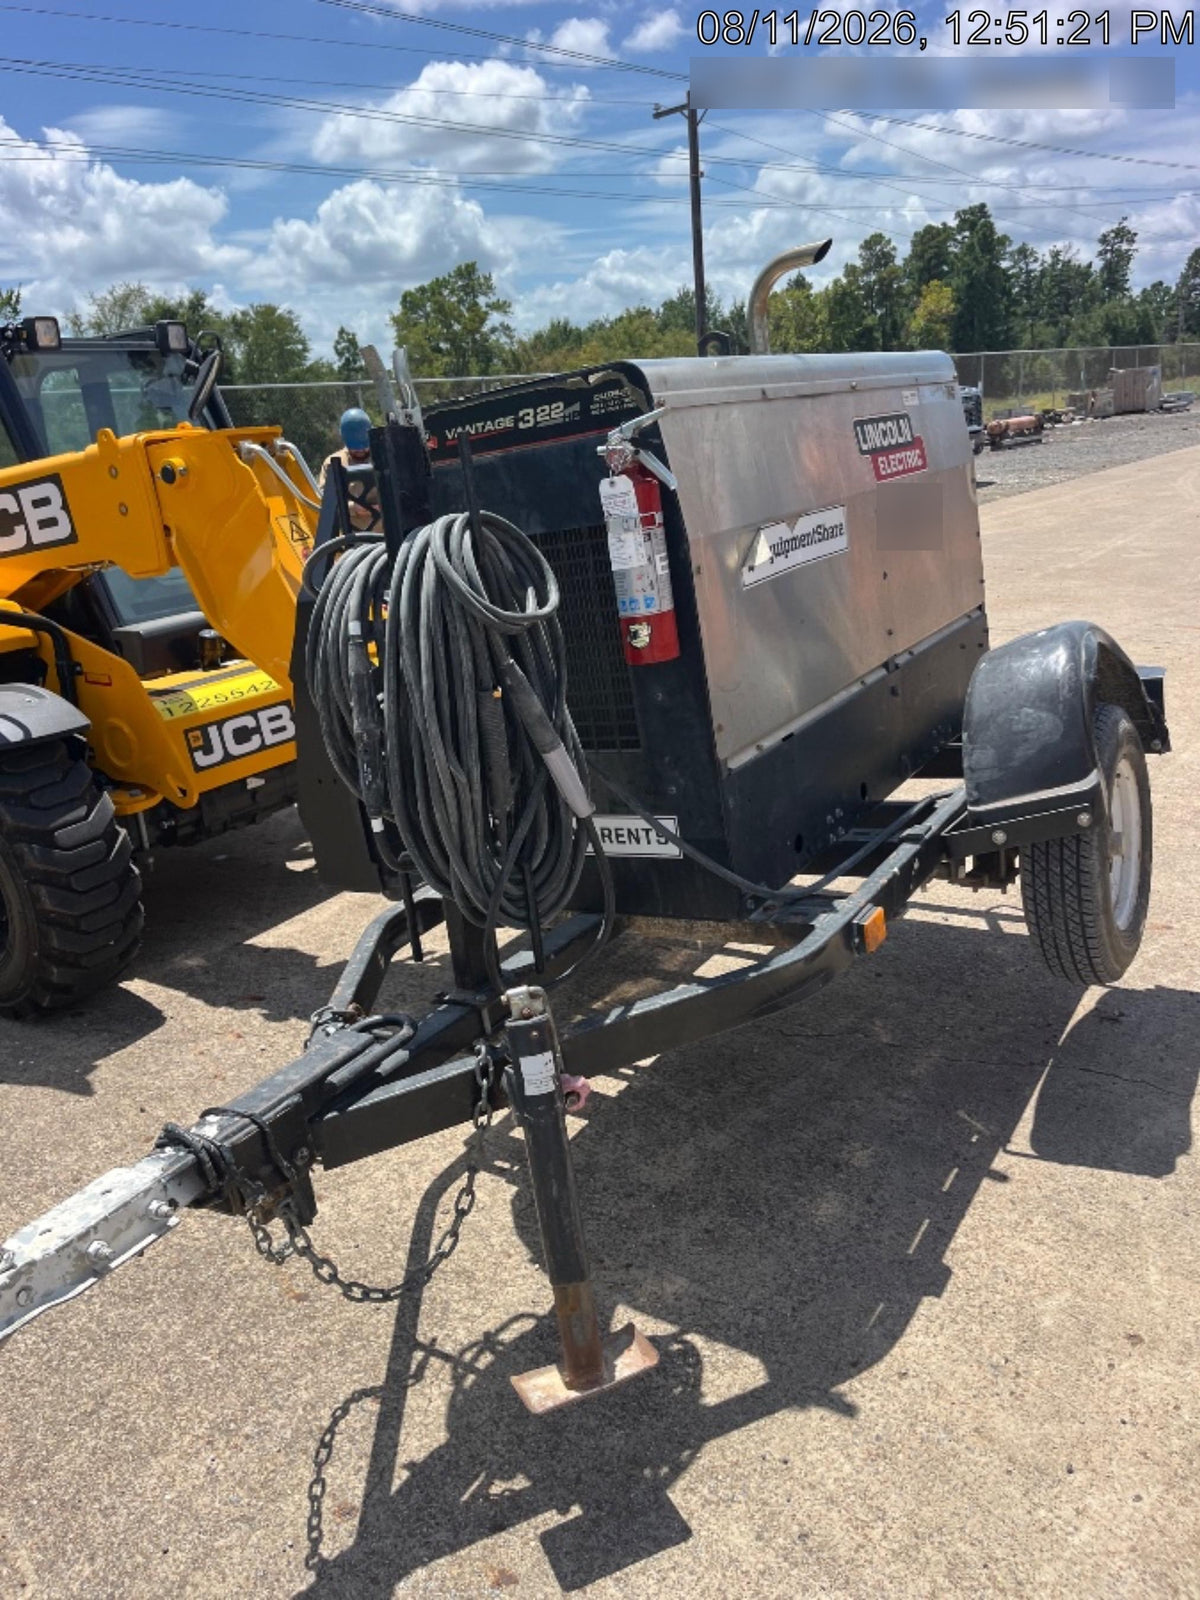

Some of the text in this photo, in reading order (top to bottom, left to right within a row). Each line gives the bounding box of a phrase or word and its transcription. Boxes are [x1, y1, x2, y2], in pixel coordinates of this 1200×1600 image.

[445, 415, 515, 440] VANTAGE
[518, 401, 565, 429] 322
[856, 418, 912, 451] LINCOLN
[877, 449, 923, 476] ELECTRIC
[750, 522, 845, 572] quipmentShare
[193, 704, 296, 767] JCB
